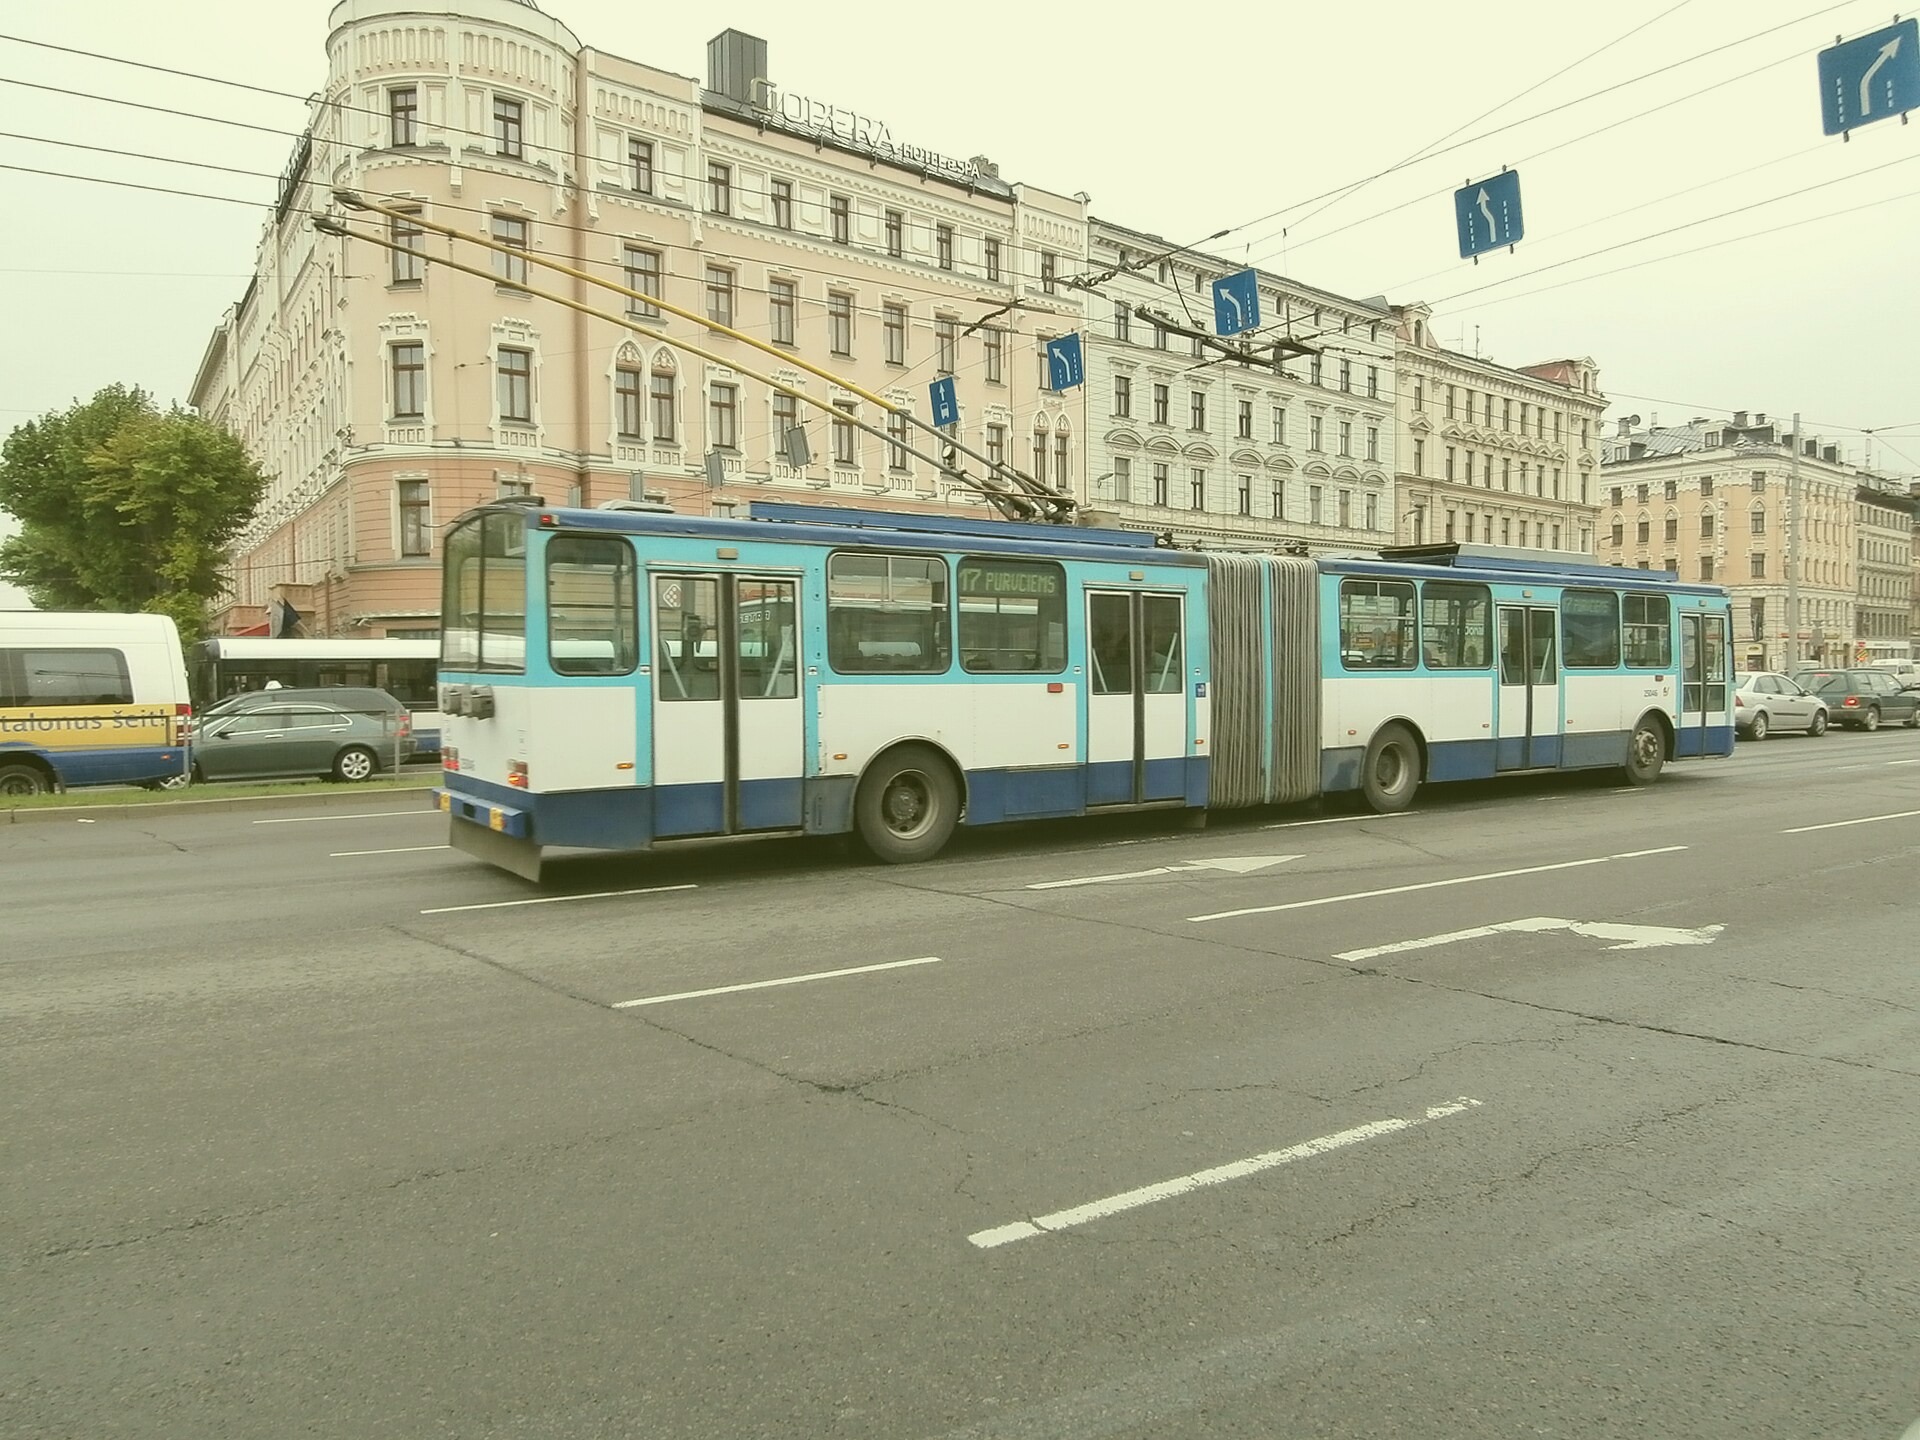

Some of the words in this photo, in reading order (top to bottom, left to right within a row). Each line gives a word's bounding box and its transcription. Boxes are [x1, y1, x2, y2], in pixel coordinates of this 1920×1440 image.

[781, 90, 895, 157] OPERA
[959, 567, 981, 592] 17
[985, 571, 1056, 594] PURVCIEMS
[1, 712, 103, 733] talonus
[112, 708, 166, 729] šeit!
